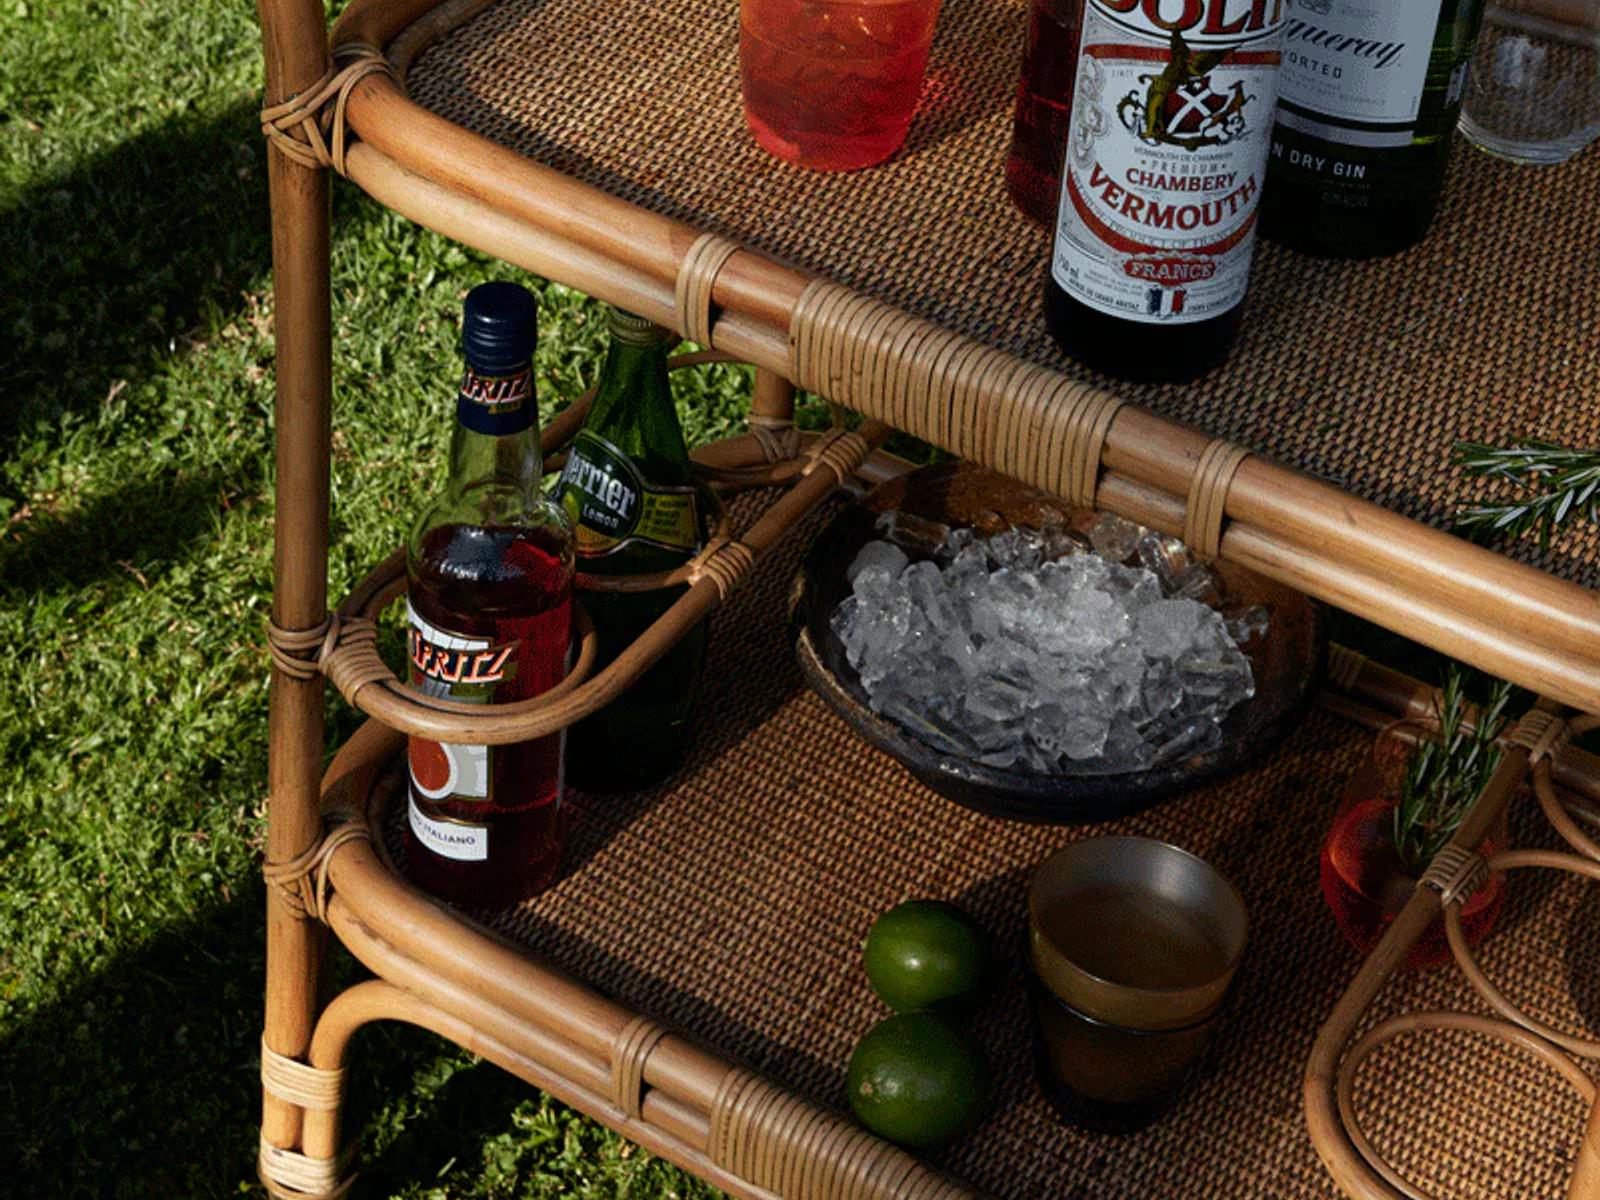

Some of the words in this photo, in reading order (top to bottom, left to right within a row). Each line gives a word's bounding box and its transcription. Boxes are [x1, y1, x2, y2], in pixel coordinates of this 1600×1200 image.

[1284, 51, 1343, 79] ORTED
[1151, 160, 1218, 175] PREMIUM
[1289, 150, 1326, 171] DRY
[1333, 161, 1366, 179] GIN
[1126, 168, 1238, 191] CHAMBERY
[1088, 162, 1258, 230] VERMOUTH
[1130, 259, 1213, 279] FRANCE
[424, 824, 476, 846] ITALIANO
